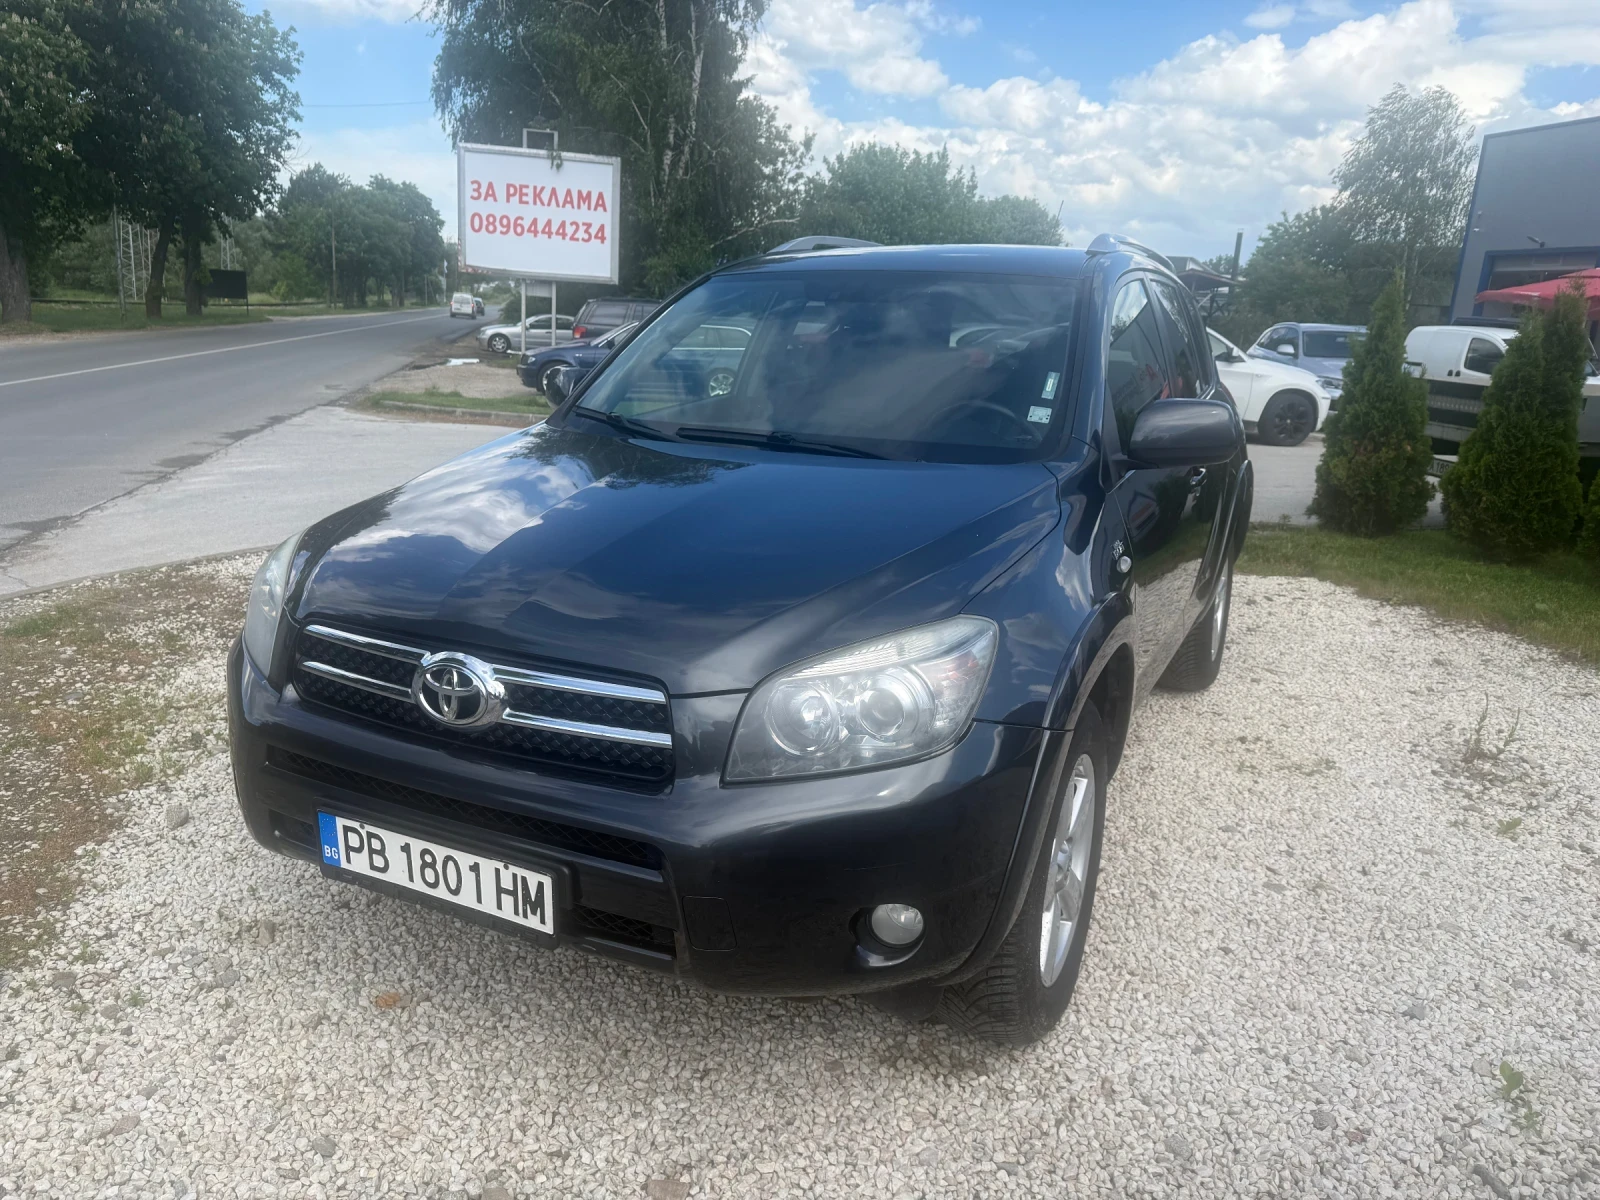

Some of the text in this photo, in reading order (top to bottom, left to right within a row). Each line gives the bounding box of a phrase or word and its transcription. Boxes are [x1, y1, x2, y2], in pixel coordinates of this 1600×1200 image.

[470, 179, 607, 212] ЗА РЕКЛАМА
[470, 212, 606, 244] 0896444234
[324, 844, 339, 860] BG
[342, 824, 546, 926] PB 1801 HM
